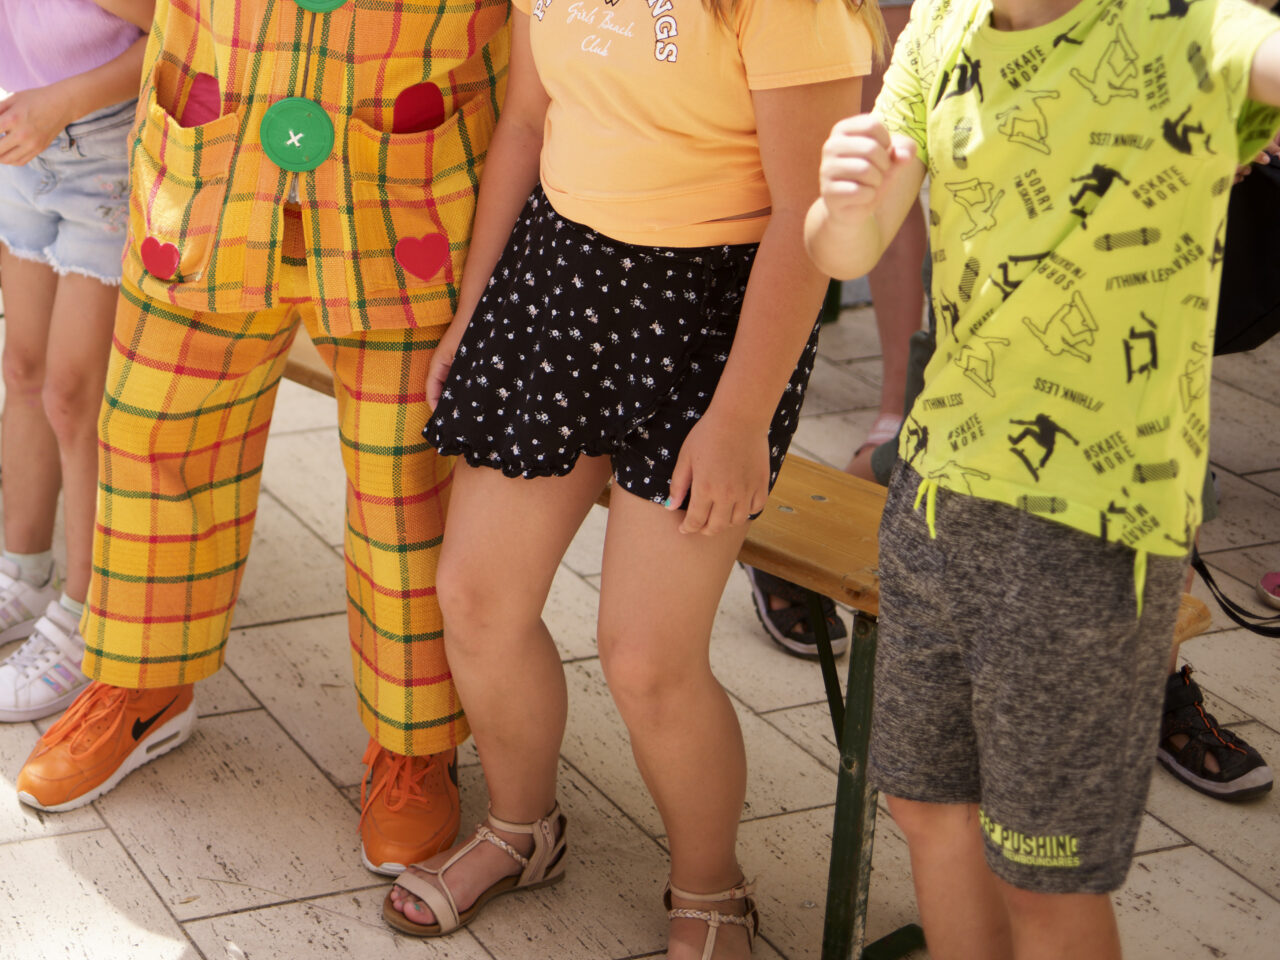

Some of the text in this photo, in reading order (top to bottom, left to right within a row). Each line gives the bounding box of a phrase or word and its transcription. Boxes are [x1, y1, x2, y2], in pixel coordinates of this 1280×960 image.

[567, 1, 635, 37] Girls Beach
[581, 34, 612, 57] Club
[1000, 45, 1045, 79] #SKATE
[1024, 168, 1055, 213] SORRY
[1131, 165, 1182, 200] #SKATE
[1141, 175, 1191, 210] MORE
[1037, 262, 1076, 291] SORR
[947, 393, 964, 407] LESS
[1033, 377, 1060, 396] LESS
[947, 413, 981, 440] #SKATE
[950, 425, 984, 452] MORE
[1083, 431, 1126, 461] #SKATE
[1092, 445, 1135, 474] MORE
